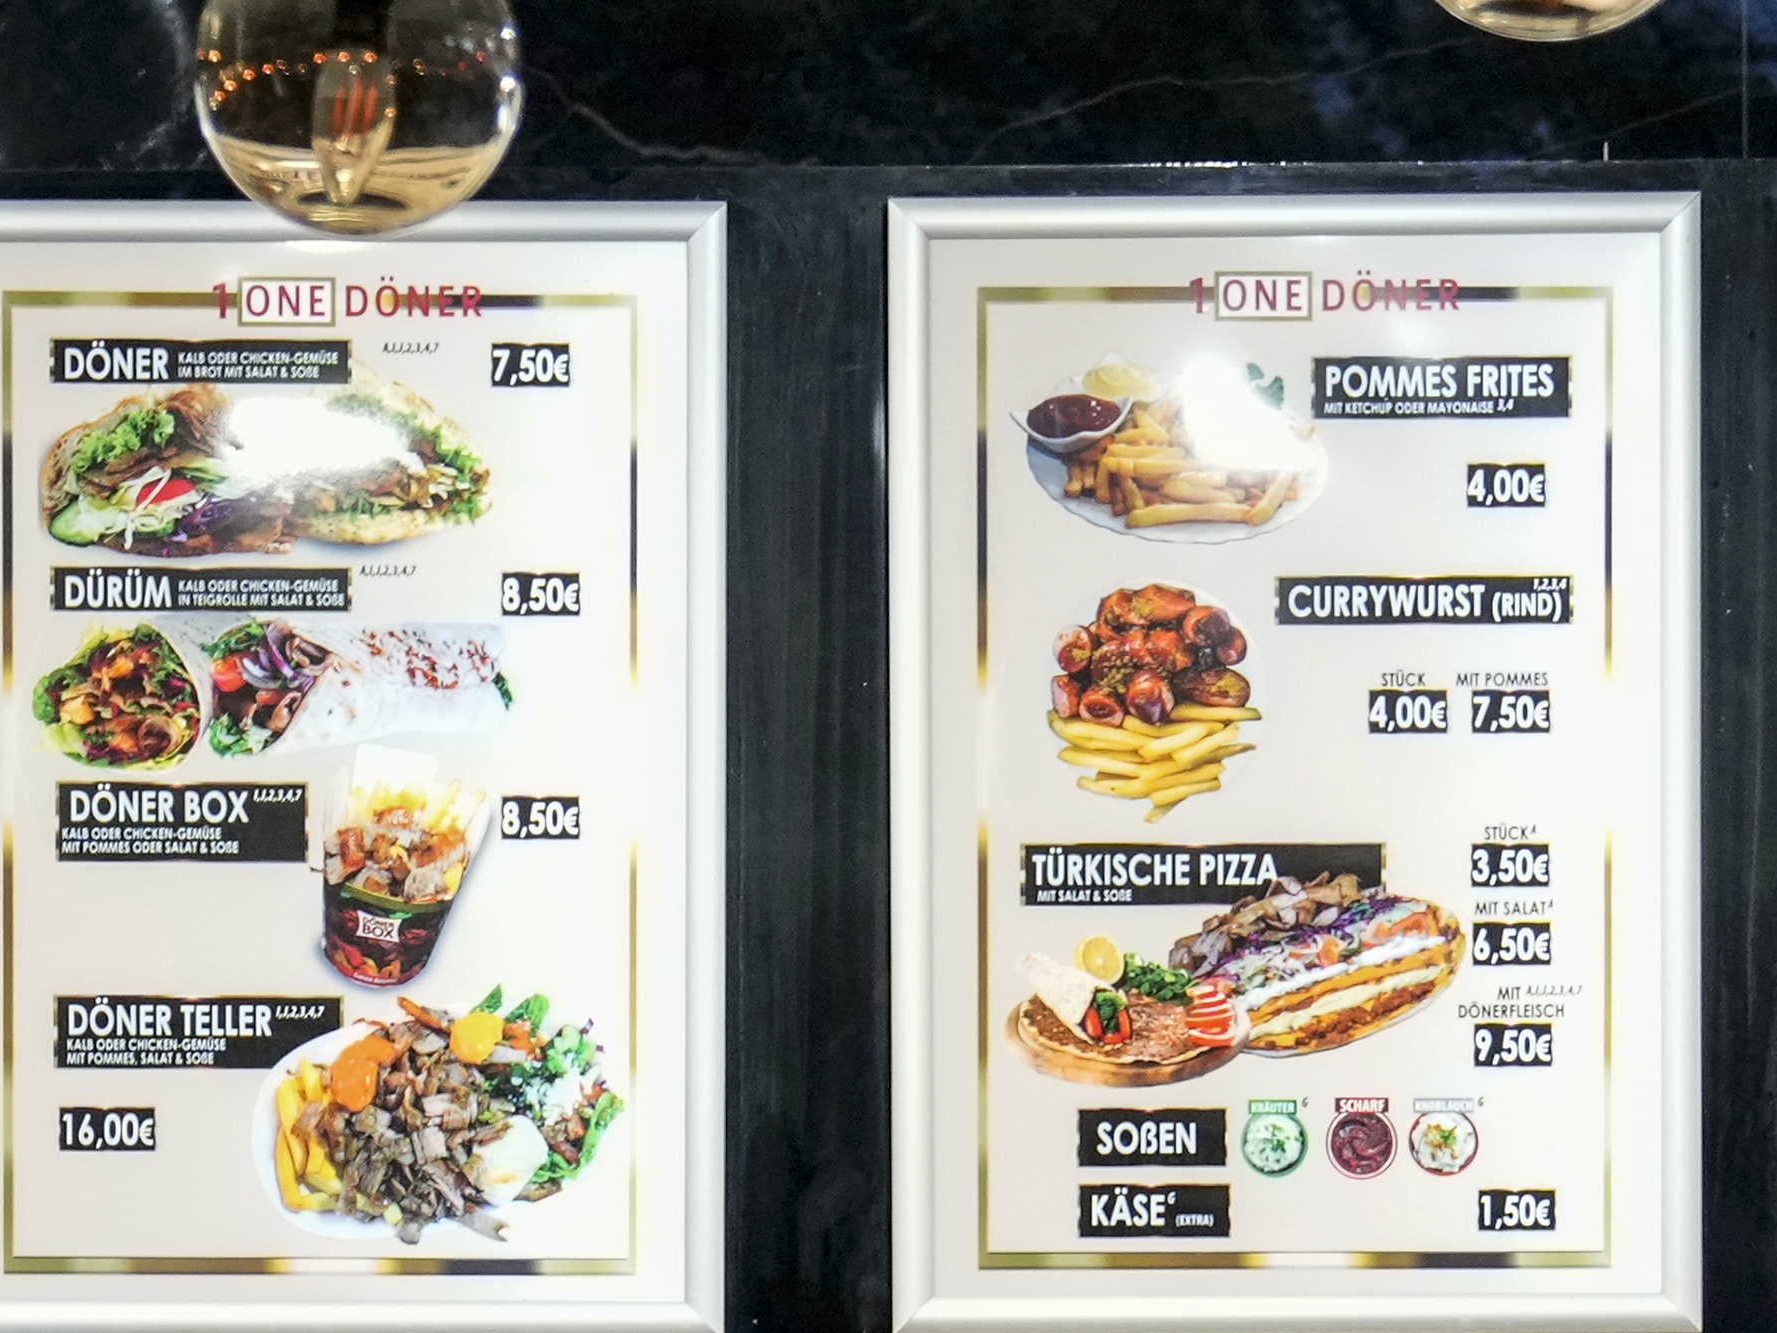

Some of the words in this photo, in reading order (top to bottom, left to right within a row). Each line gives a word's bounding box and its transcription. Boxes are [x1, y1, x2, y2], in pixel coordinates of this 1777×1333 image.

[213, 283, 229, 318] 1
[246, 284, 325, 317] ONE
[346, 277, 483, 317] DÖNER
[1190, 277, 1205, 313] 1
[1223, 279, 1302, 311] ONE
[1323, 271, 1461, 311] DÖNER
[64, 340, 169, 380] DÖNER
[195, 365, 222, 378] BROT
[245, 365, 277, 378] SALAT
[207, 351, 238, 364] ODER
[240, 349, 339, 365] CHICKEN-GEMÜSE
[492, 348, 569, 386] 7,50€
[1325, 364, 1458, 398] POMMES
[1467, 363, 1554, 398] FRITES
[1345, 401, 1392, 414] KETCHUP
[1468, 468, 1545, 506] 4,00€
[64, 568, 172, 608] DÜRÜM
[192, 593, 248, 606] TEIGROLLE
[240, 577, 339, 593] CHICKEN-GEMÜSE
[502, 577, 580, 615] 8,50€
[1288, 583, 1486, 618] CURRYWURST
[1492, 591, 1562, 623] (RIND)
[1381, 671, 1425, 687] STÜCK
[1456, 672, 1480, 686] MIT
[1485, 672, 1548, 687] POMMES
[1370, 695, 1447, 732] 4,00€
[1472, 695, 1550, 732] 7,50€
[70, 783, 174, 823] DÖNER
[184, 790, 249, 824] BOX
[502, 801, 579, 839] 8,50€
[82, 841, 132, 854] POMMES
[124, 825, 222, 840] CHICKEN-GEMÜSE
[1484, 824, 1529, 841] STÜCK
[1031, 846, 1191, 887] TÜRKISCHE
[1199, 853, 1282, 886] PIZZA
[1472, 848, 1549, 886] 3,50€
[1058, 889, 1091, 902] SALAT
[1475, 901, 1498, 915] MIT
[1503, 901, 1546, 916] SALAT
[1473, 927, 1550, 965] 6,50€
[1458, 1002, 1565, 1019] DÖNERFLEISCH
[1497, 986, 1521, 1000] MIT
[68, 996, 172, 1037] DÖNER
[180, 1004, 272, 1037] TELLER
[67, 1038, 93, 1051] KALB
[128, 1036, 226, 1051] CHICKEN-GEMÜSE
[1475, 1028, 1552, 1066] 9,50€
[1340, 1099, 1385, 1113] SCHARF
[62, 1112, 154, 1150] 16,00€
[1091, 1186, 1166, 1227] KÄSE
[1175, 1213, 1214, 1227] (EXTRA)
[1480, 1194, 1551, 1230] 1,50€
